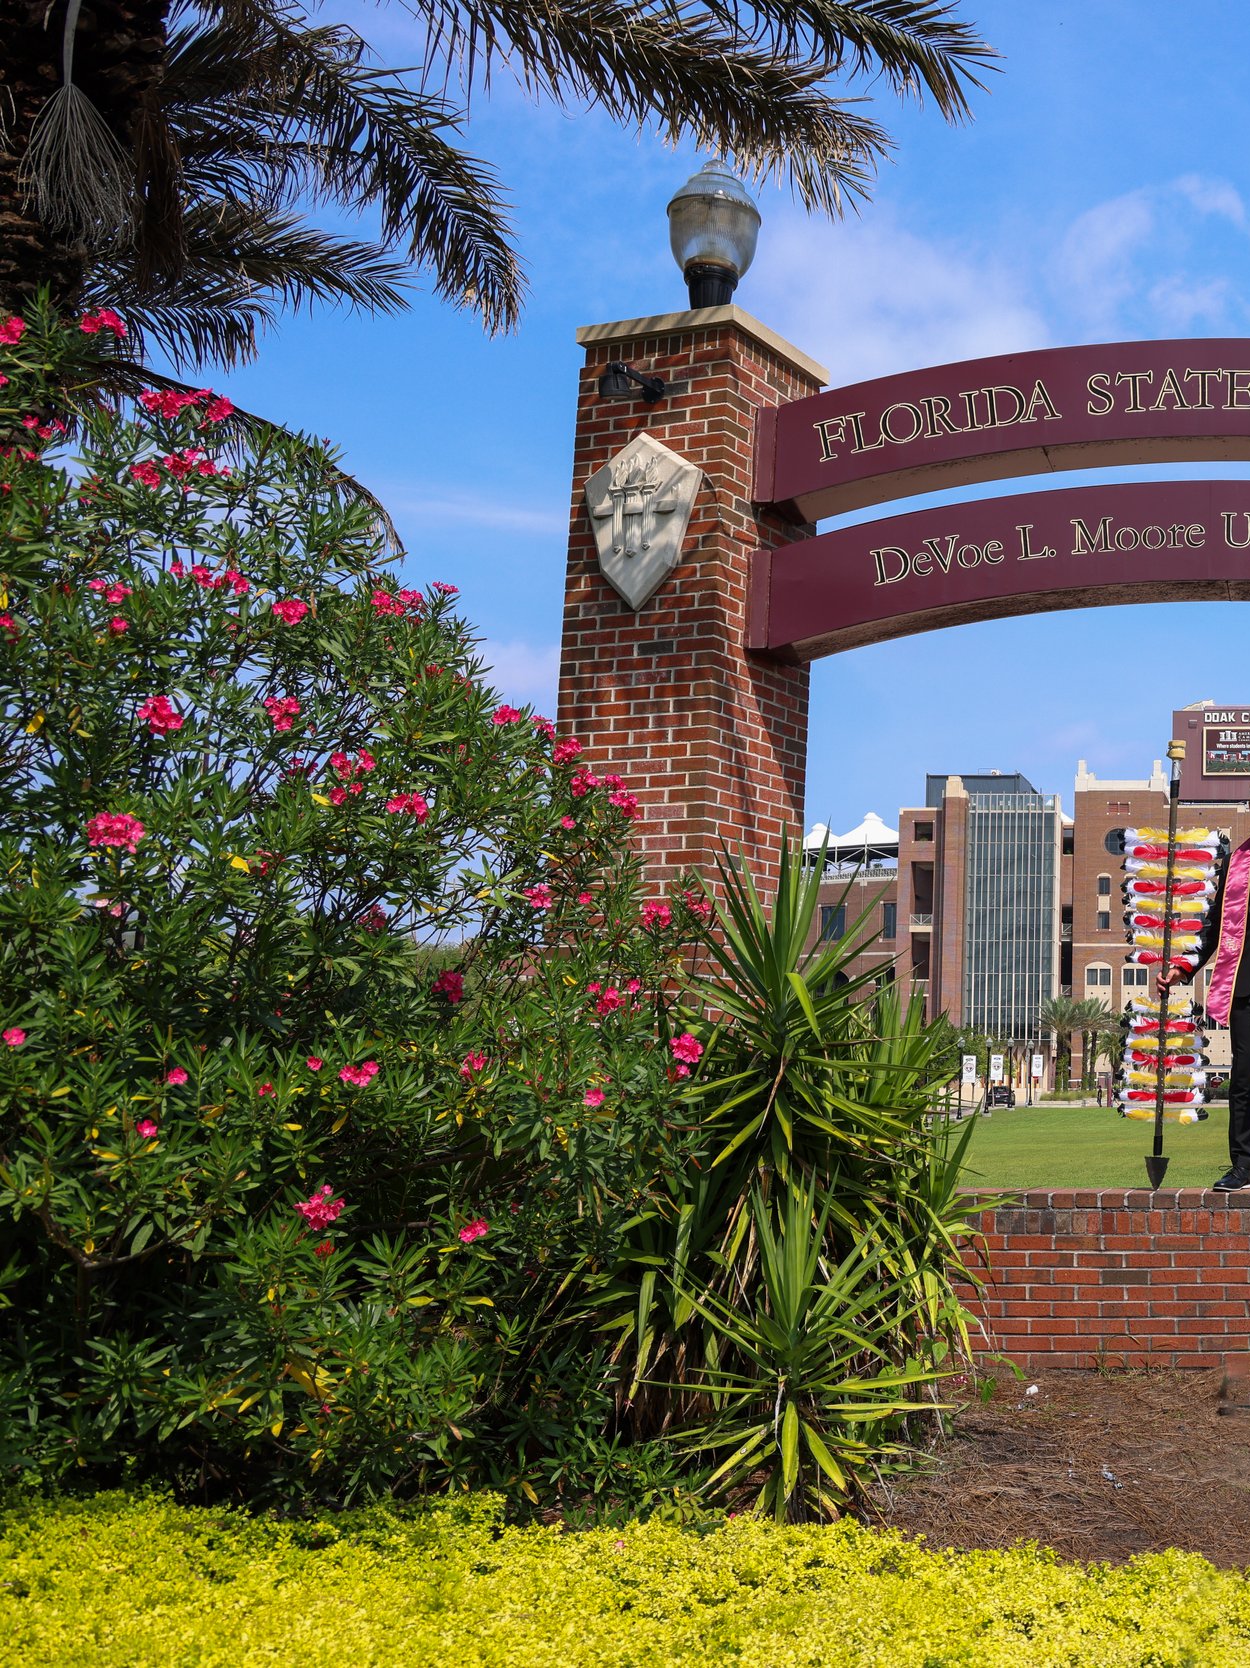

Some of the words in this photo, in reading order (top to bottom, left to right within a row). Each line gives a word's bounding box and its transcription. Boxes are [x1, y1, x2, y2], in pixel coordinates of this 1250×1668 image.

[813, 380, 1062, 462] FLORIDA
[870, 534, 1004, 586] DeVoe
[1016, 524, 1057, 561] L.
[1071, 516, 1205, 555] Moore
[1204, 712, 1236, 723] DOAK
